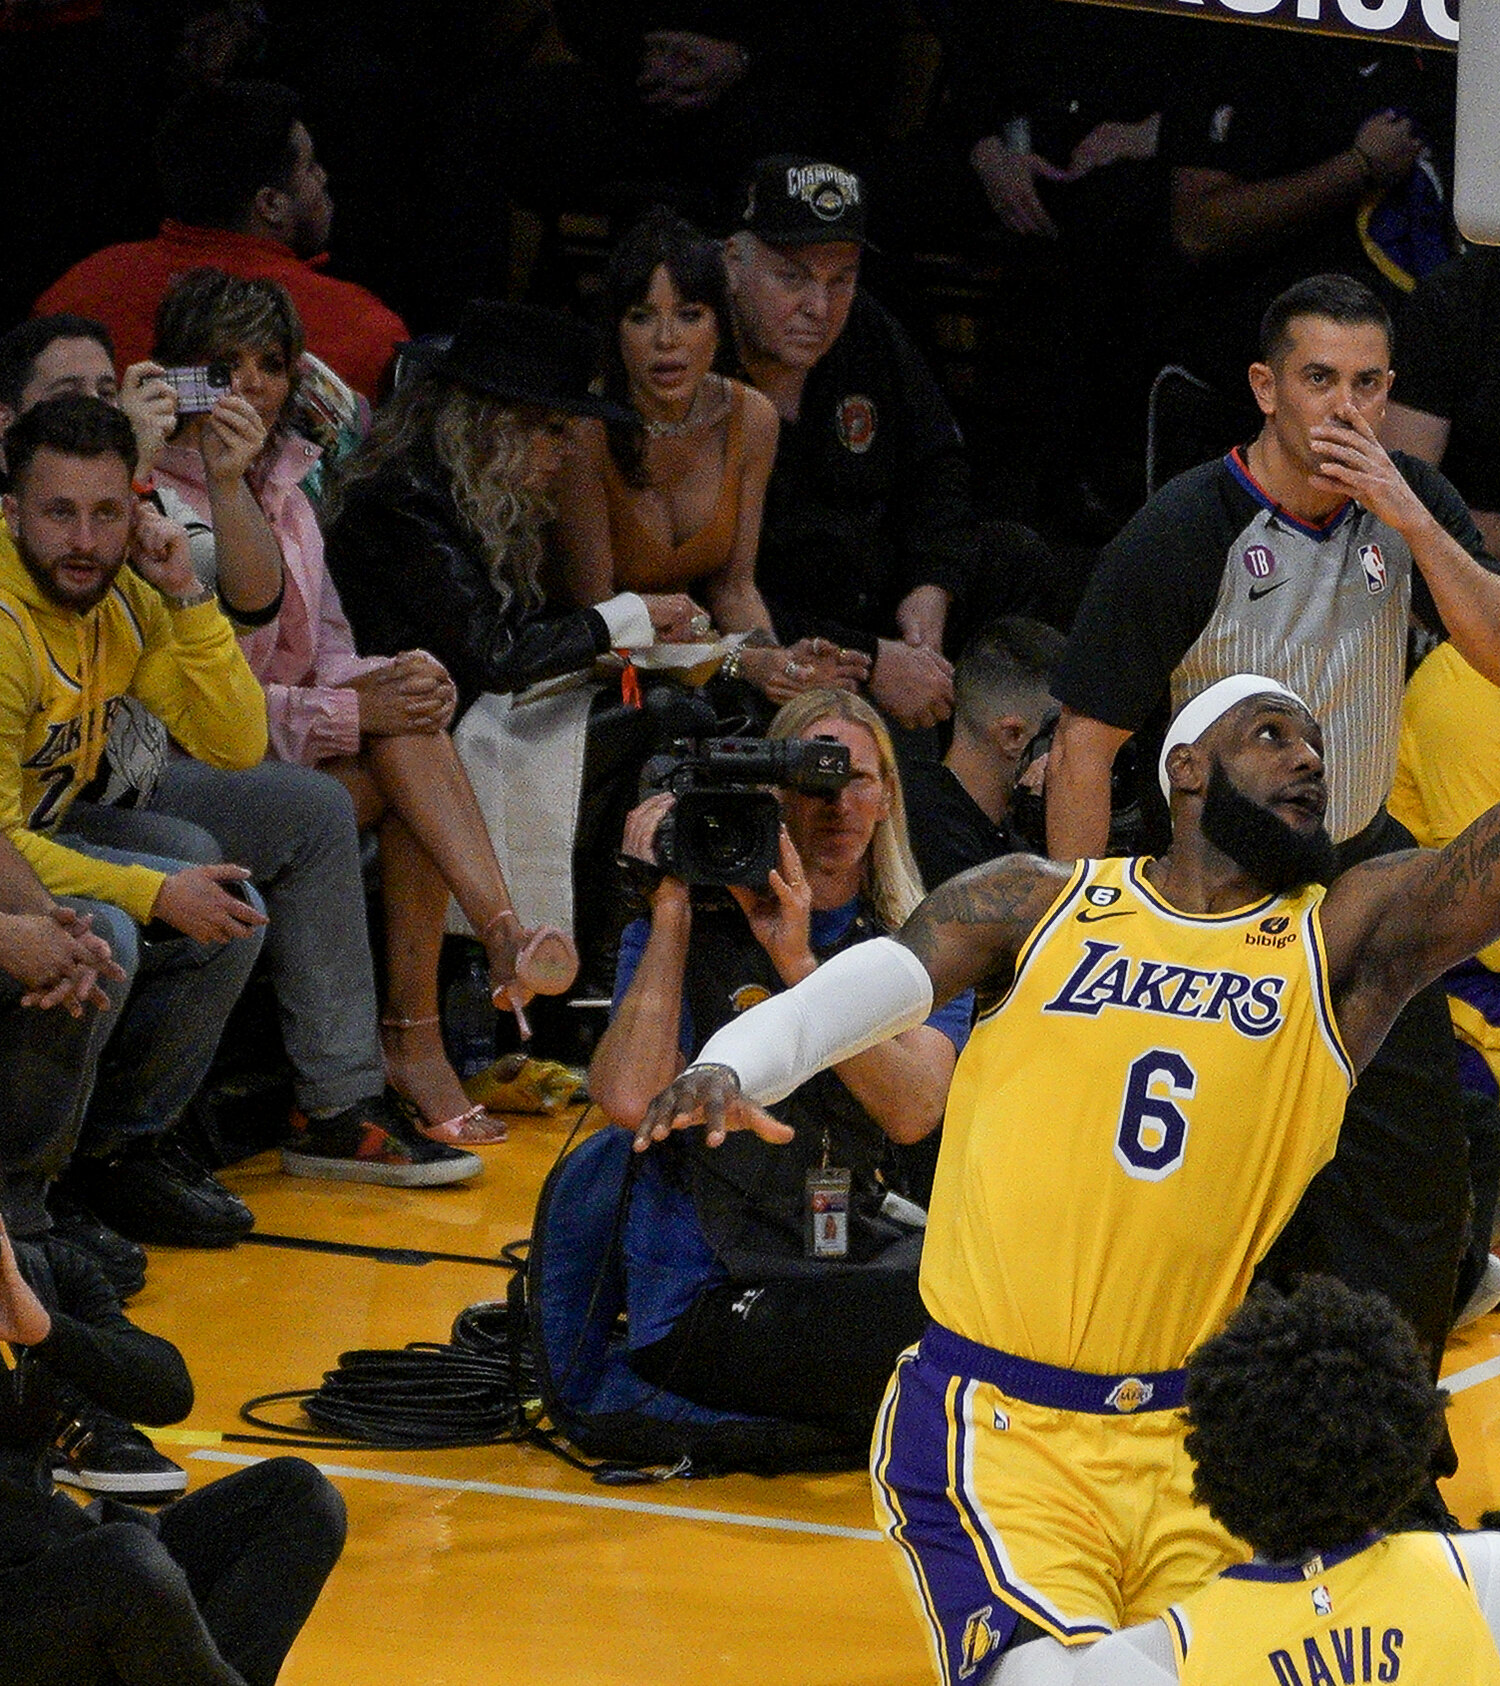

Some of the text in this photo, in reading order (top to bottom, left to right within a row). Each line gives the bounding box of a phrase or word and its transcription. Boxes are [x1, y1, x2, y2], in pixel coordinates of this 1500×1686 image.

[1247, 549, 1270, 577] TB
[1091, 887, 1115, 907] 6
[1245, 933, 1297, 949] bibigo
[1042, 940, 1286, 1038] LAKERS
[1114, 1047, 1196, 1182] 6
[1268, 1626, 1404, 1686] DAVIS
